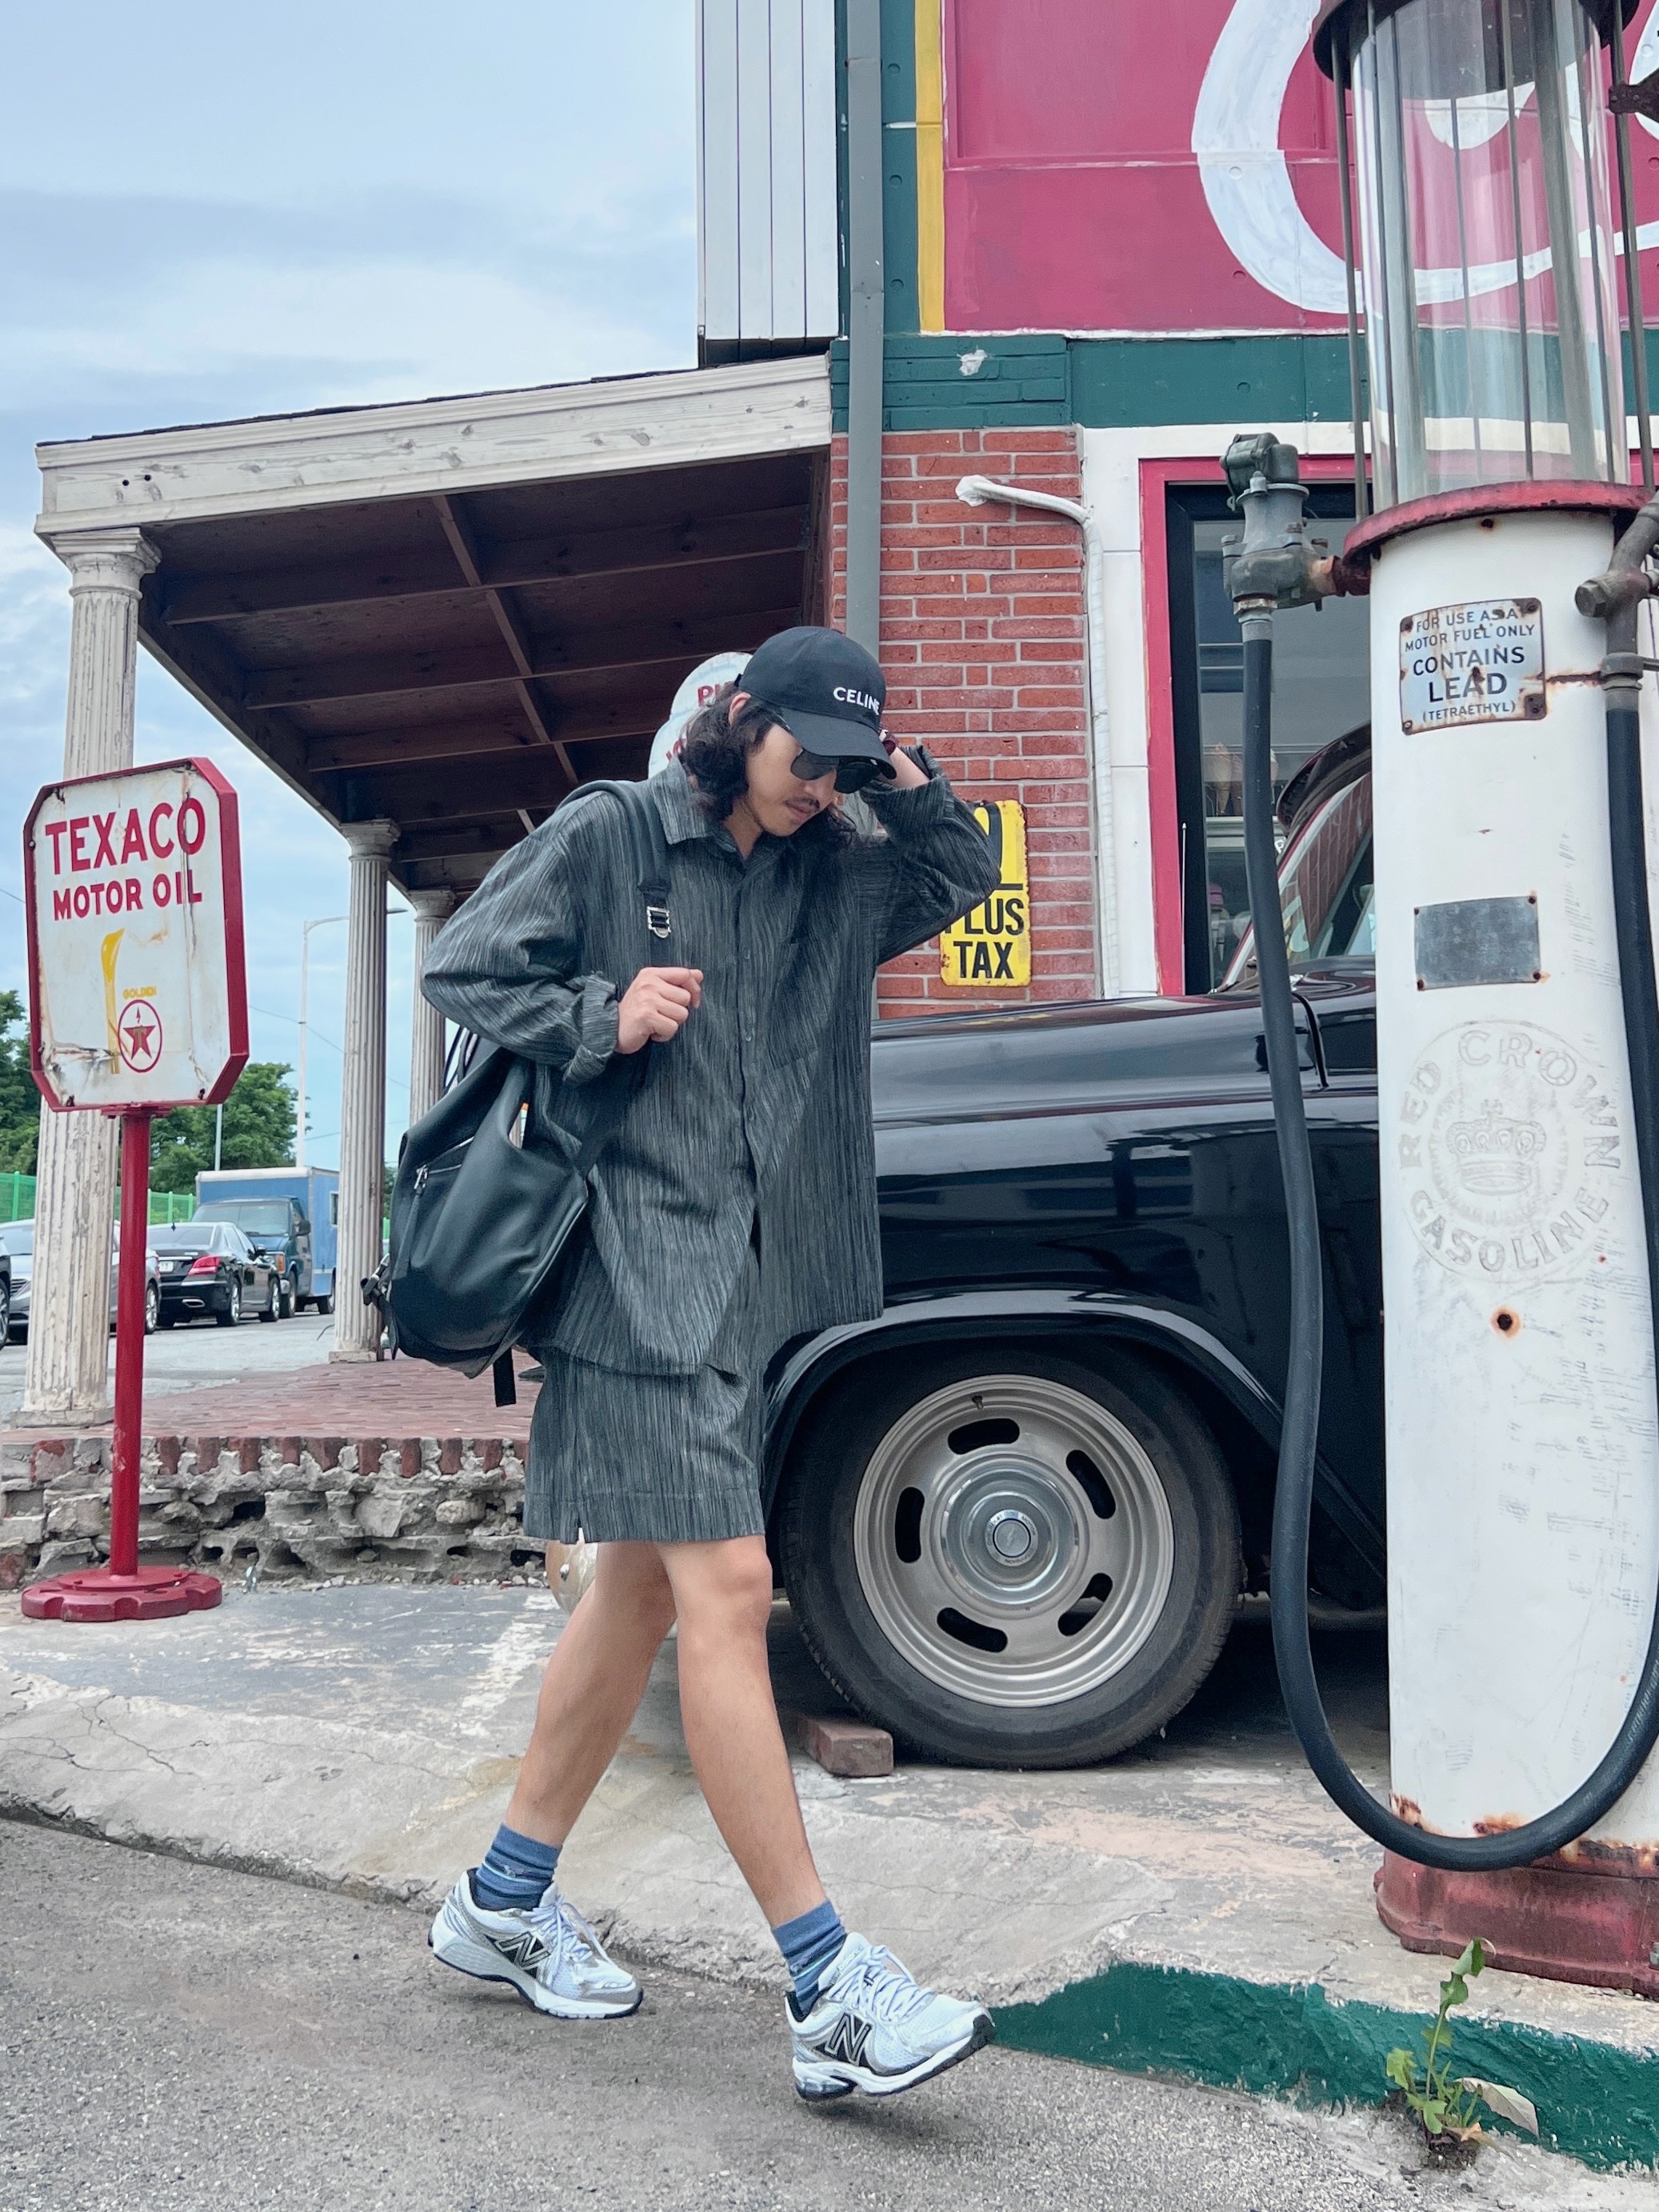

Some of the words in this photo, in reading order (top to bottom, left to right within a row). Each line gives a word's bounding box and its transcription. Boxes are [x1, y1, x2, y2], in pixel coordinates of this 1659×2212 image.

[1405, 632, 1448, 653] MOTOR
[1453, 626, 1491, 641] FUEL
[1496, 624, 1535, 638] ONLY
[1416, 617, 1440, 633] FOR
[1445, 610, 1475, 626] USE
[1480, 608, 1505, 622] AS
[1505, 607, 1519, 620] A
[1413, 646, 1525, 676] CONTAINS
[1428, 672, 1508, 703] LEAD
[1421, 700, 1517, 722] (TETRAETHYL)
[45, 797, 206, 875] TEXACO
[52, 878, 144, 922] MOTOR
[153, 869, 203, 908] OIL
[945, 897, 1025, 936] LUS
[953, 941, 1014, 980] TAX
[1398, 1060, 1442, 1170] RED
[1457, 1029, 1621, 1169] CROWN
[1410, 1187, 1610, 1273] GASOLINE
